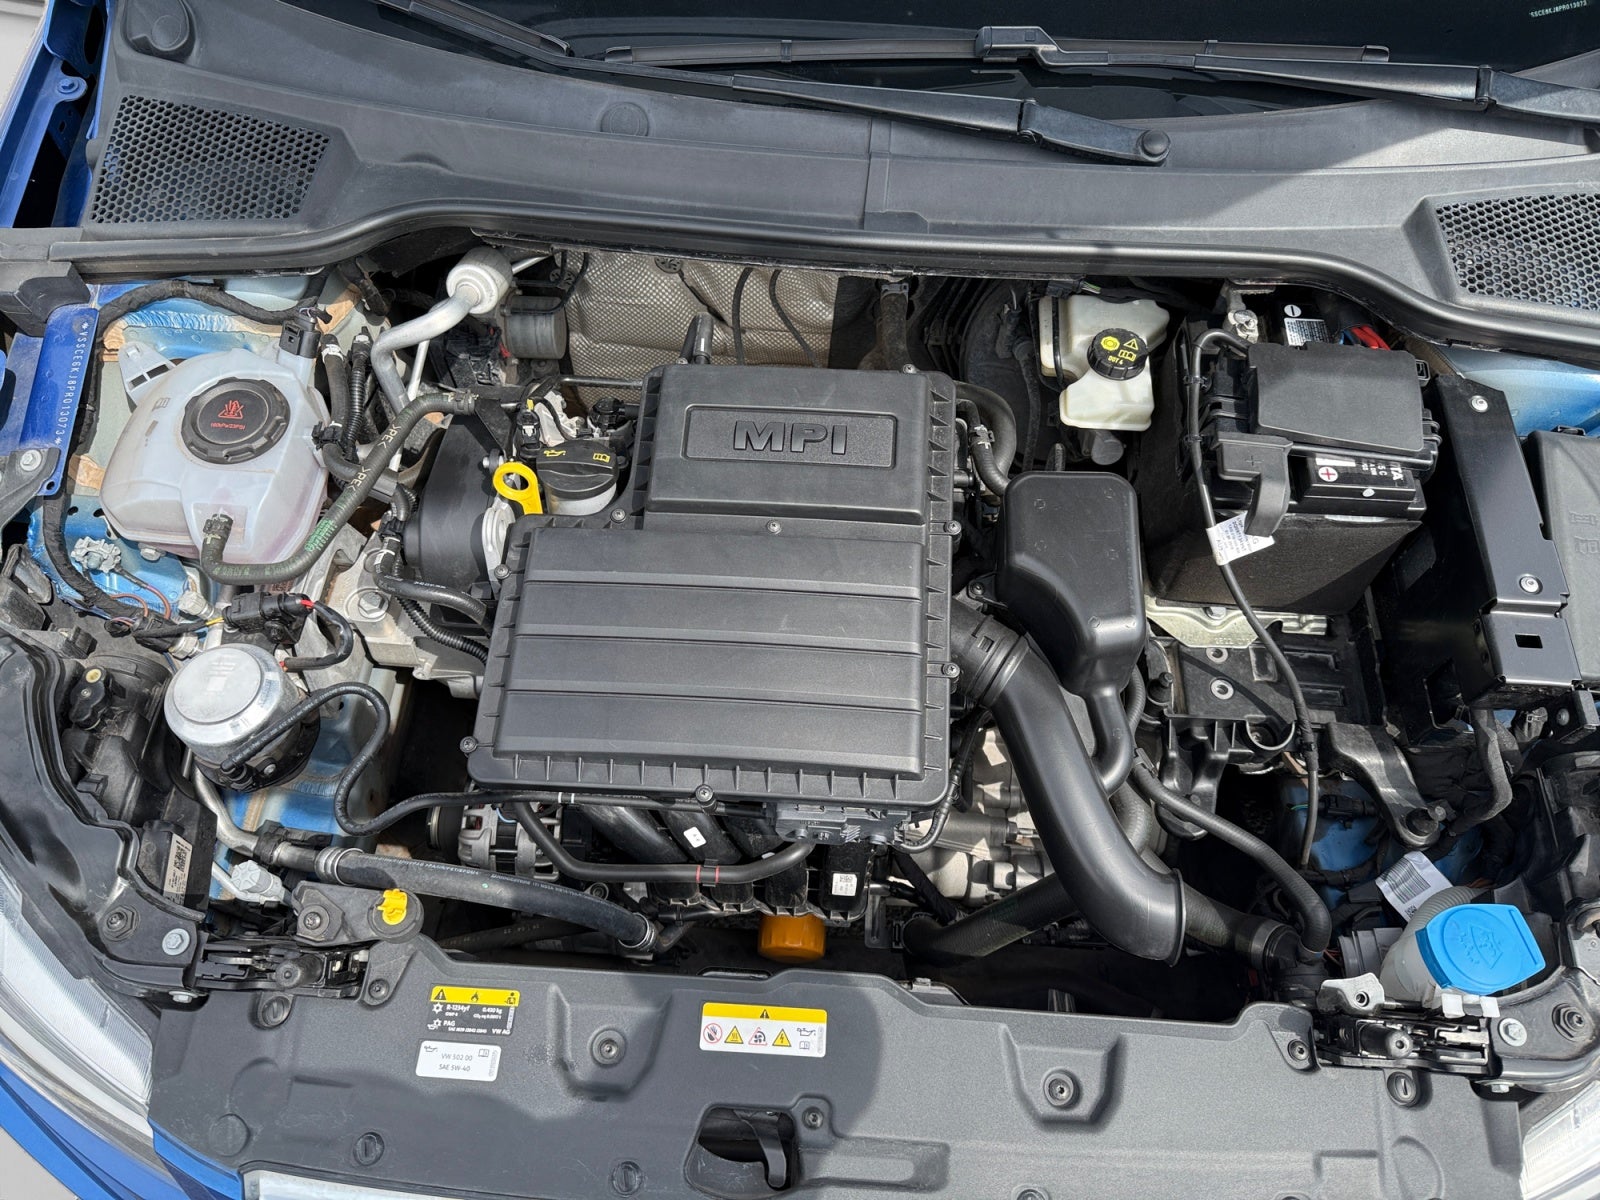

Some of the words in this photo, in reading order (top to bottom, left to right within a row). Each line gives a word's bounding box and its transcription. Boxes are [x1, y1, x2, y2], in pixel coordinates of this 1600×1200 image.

[733, 420, 848, 455] MPI
[446, 1004, 470, 1013] R-1234yf
[450, 1064, 471, 1072] 5W-40
